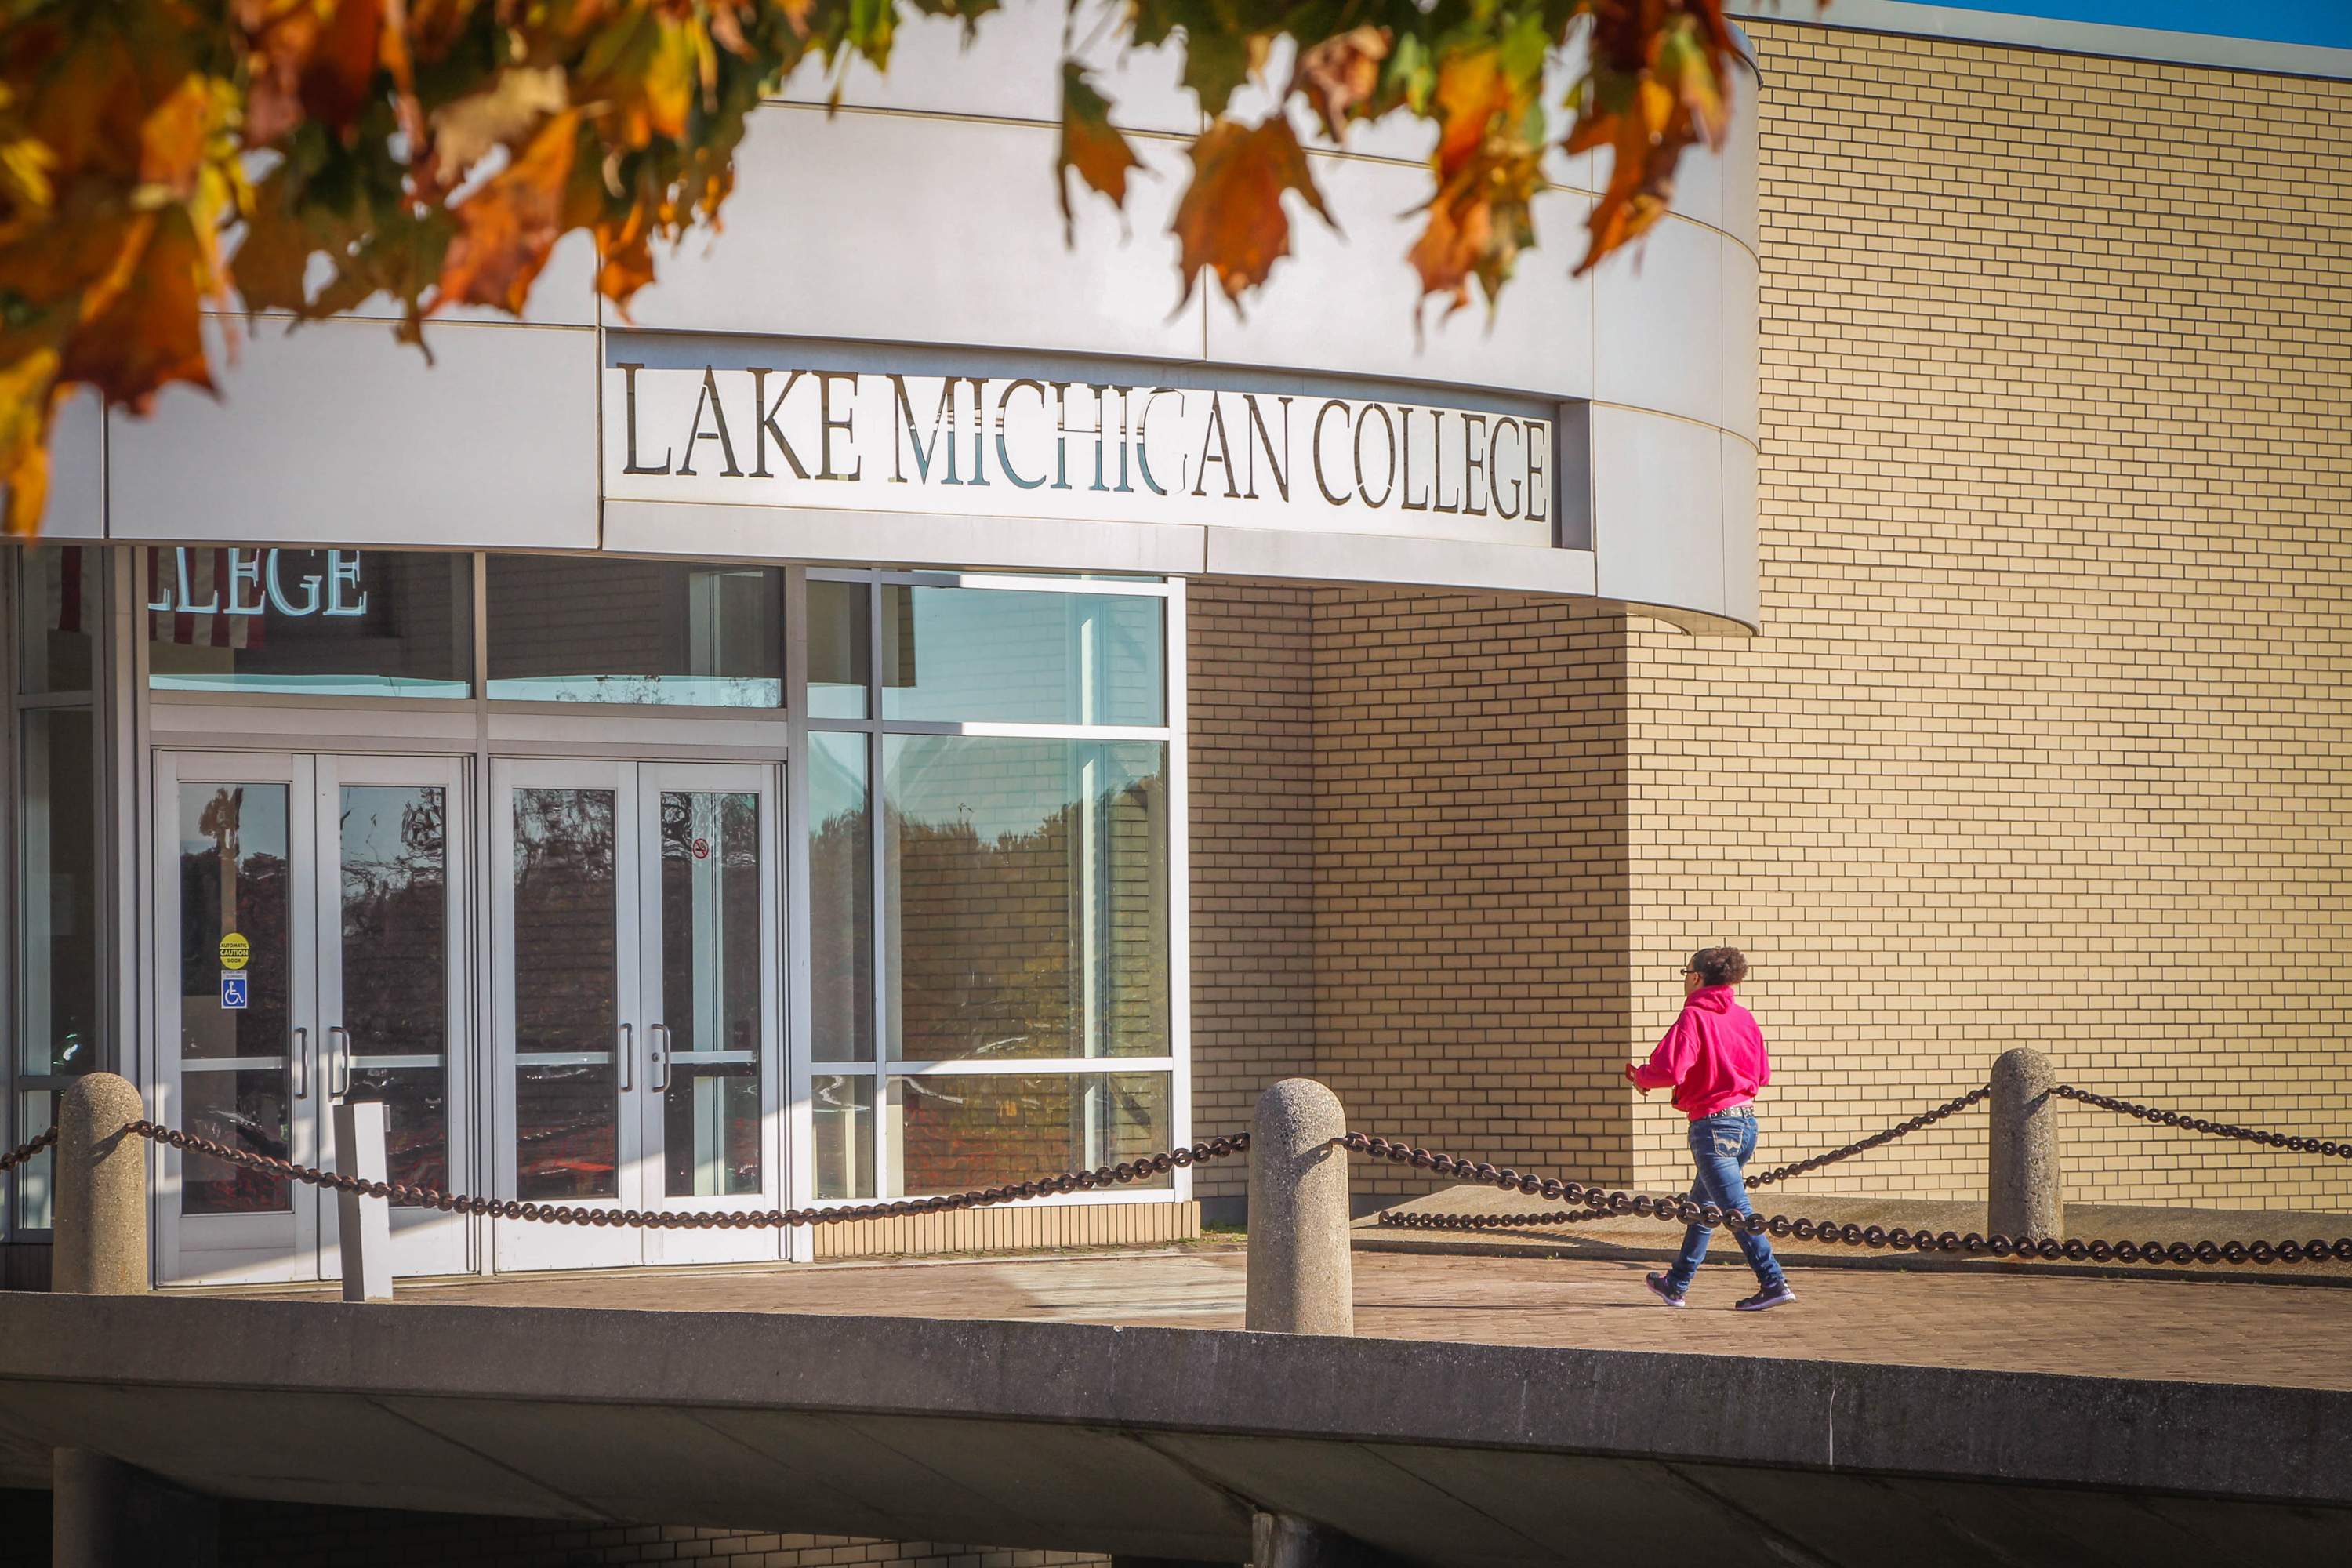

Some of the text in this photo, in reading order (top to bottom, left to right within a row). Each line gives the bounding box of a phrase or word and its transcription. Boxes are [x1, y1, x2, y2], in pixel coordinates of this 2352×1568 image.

[616, 362, 1547, 522] LAKE MICHIGAN COLLEGE
